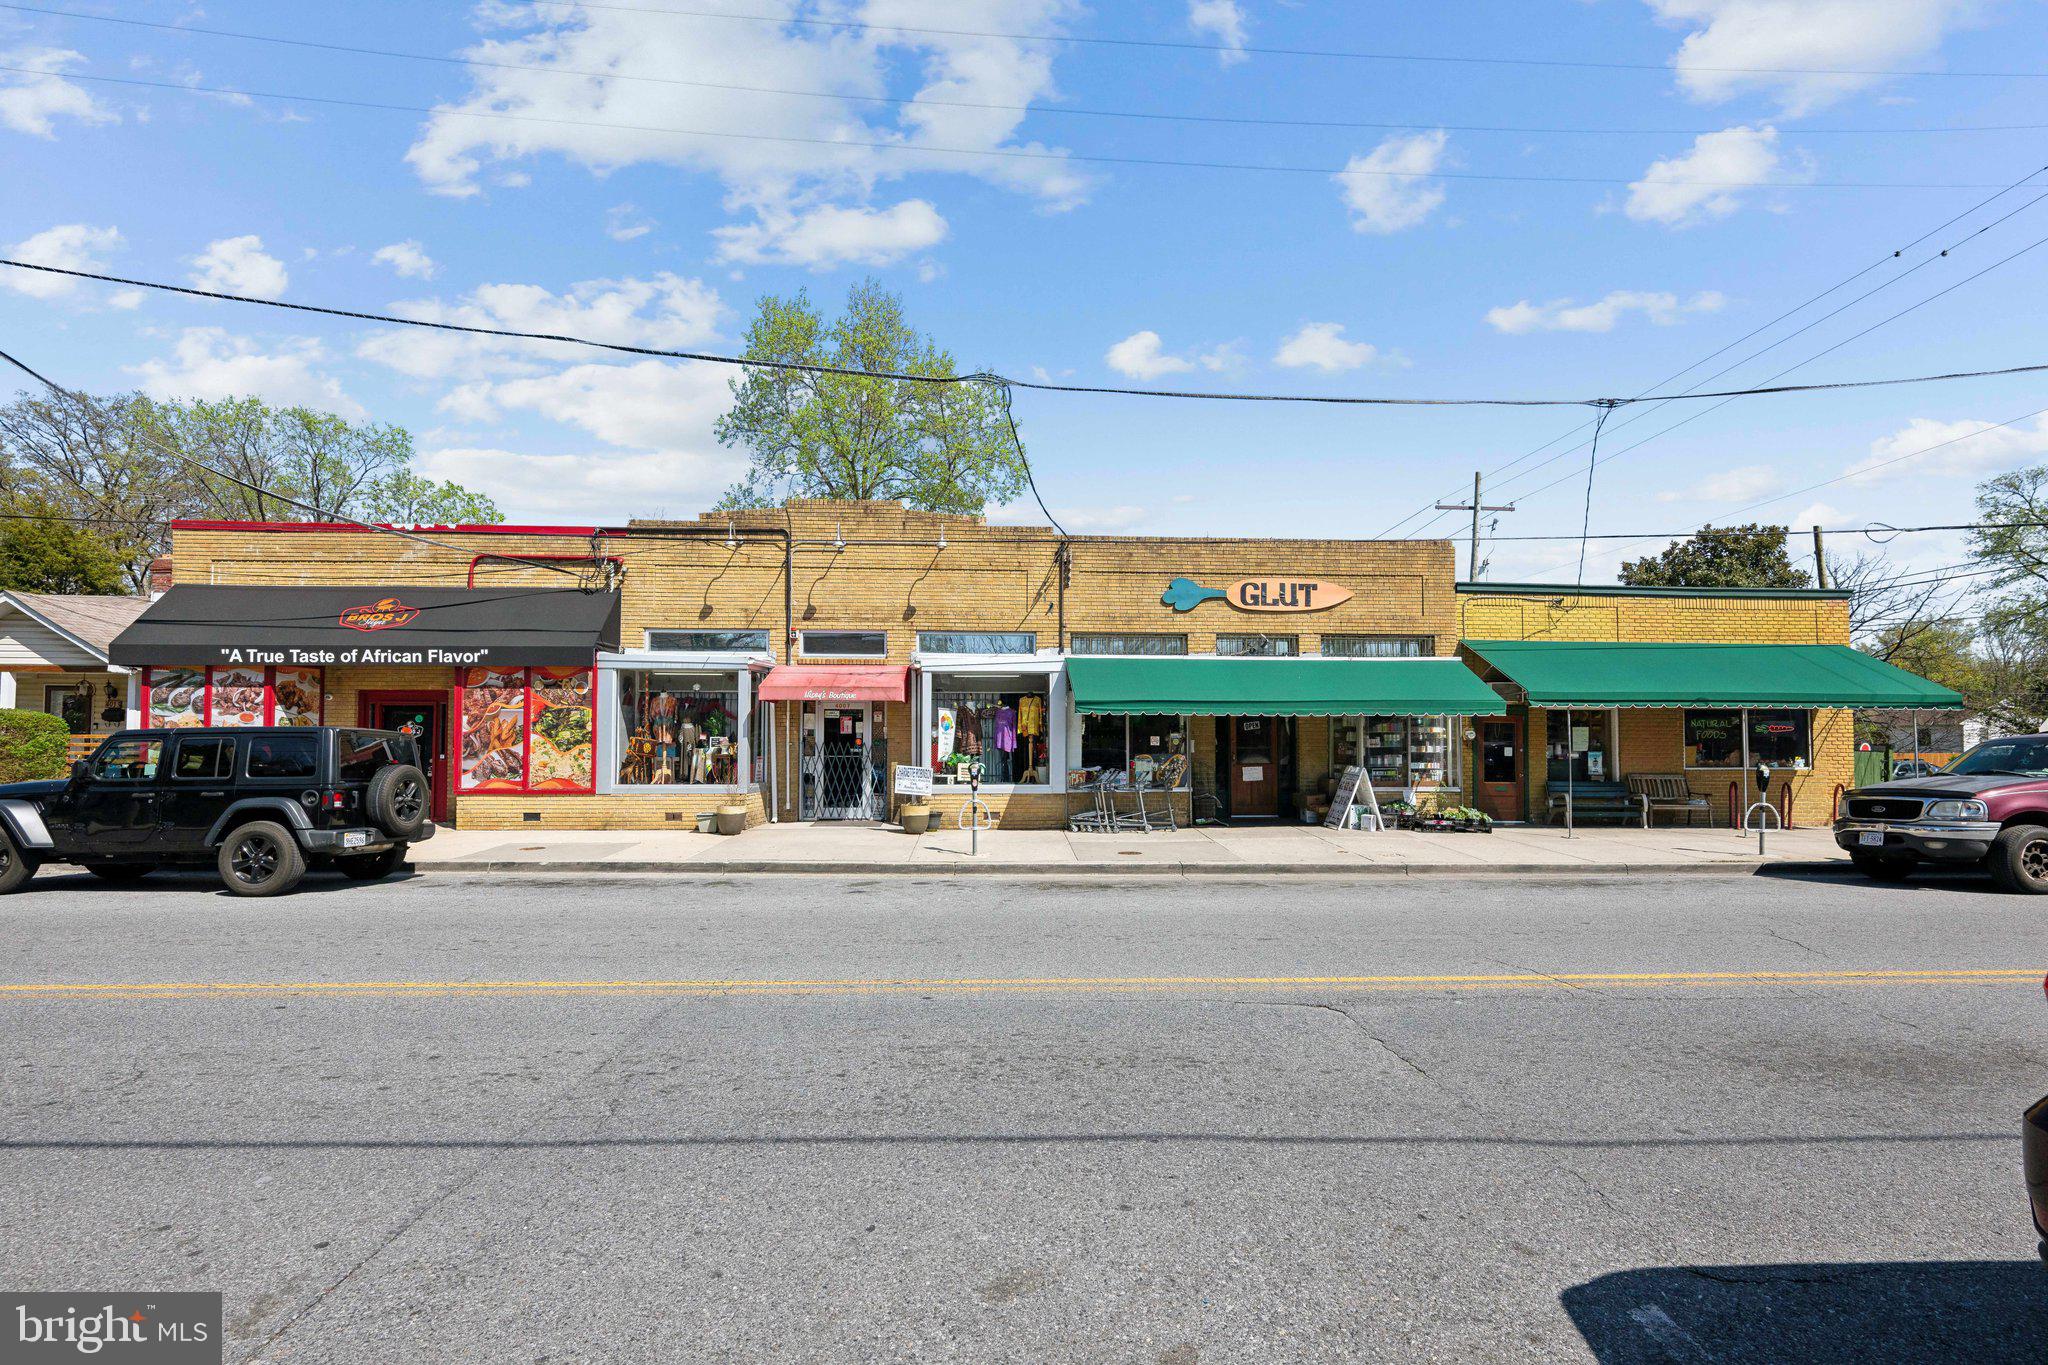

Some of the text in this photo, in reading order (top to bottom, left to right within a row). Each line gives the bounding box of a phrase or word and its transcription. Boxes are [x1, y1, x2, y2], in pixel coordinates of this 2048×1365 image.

[1240, 582, 1317, 607] GLUT
[347, 612, 409, 623] BROS J
[221, 648, 489, 663] "A True Taste of African Flavor"
[828, 690, 857, 700] Boutique
[1244, 721, 1260, 730] OPEN
[1690, 719, 1732, 728] NATURAL
[1696, 729, 1727, 740] FOODS
